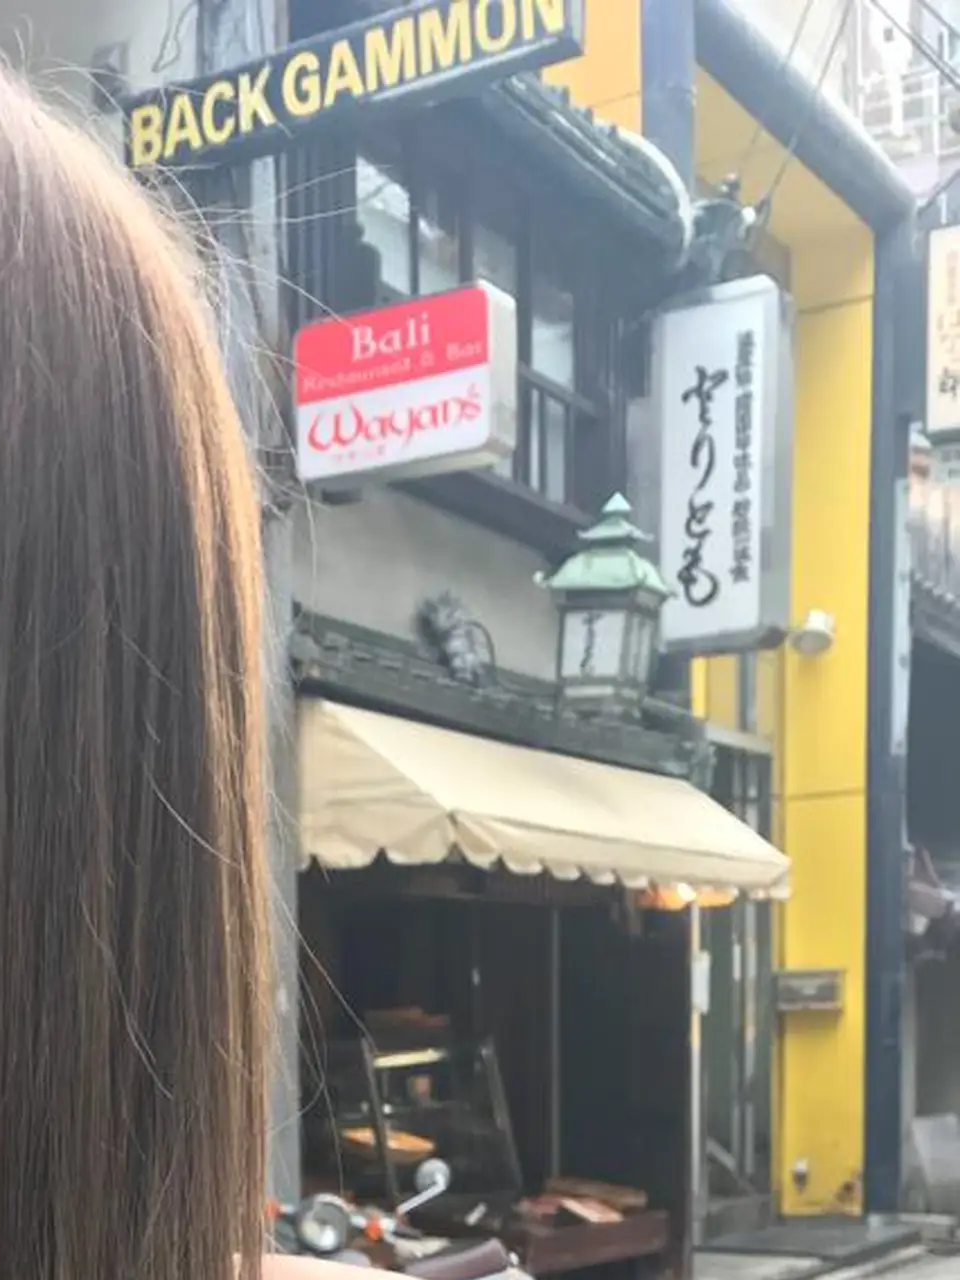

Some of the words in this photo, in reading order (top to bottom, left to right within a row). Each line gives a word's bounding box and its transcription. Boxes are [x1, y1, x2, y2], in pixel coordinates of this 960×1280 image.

[130, 62, 276, 167] BACK
[282, 0, 565, 118] GAMMON
[352, 312, 431, 362] Bali
